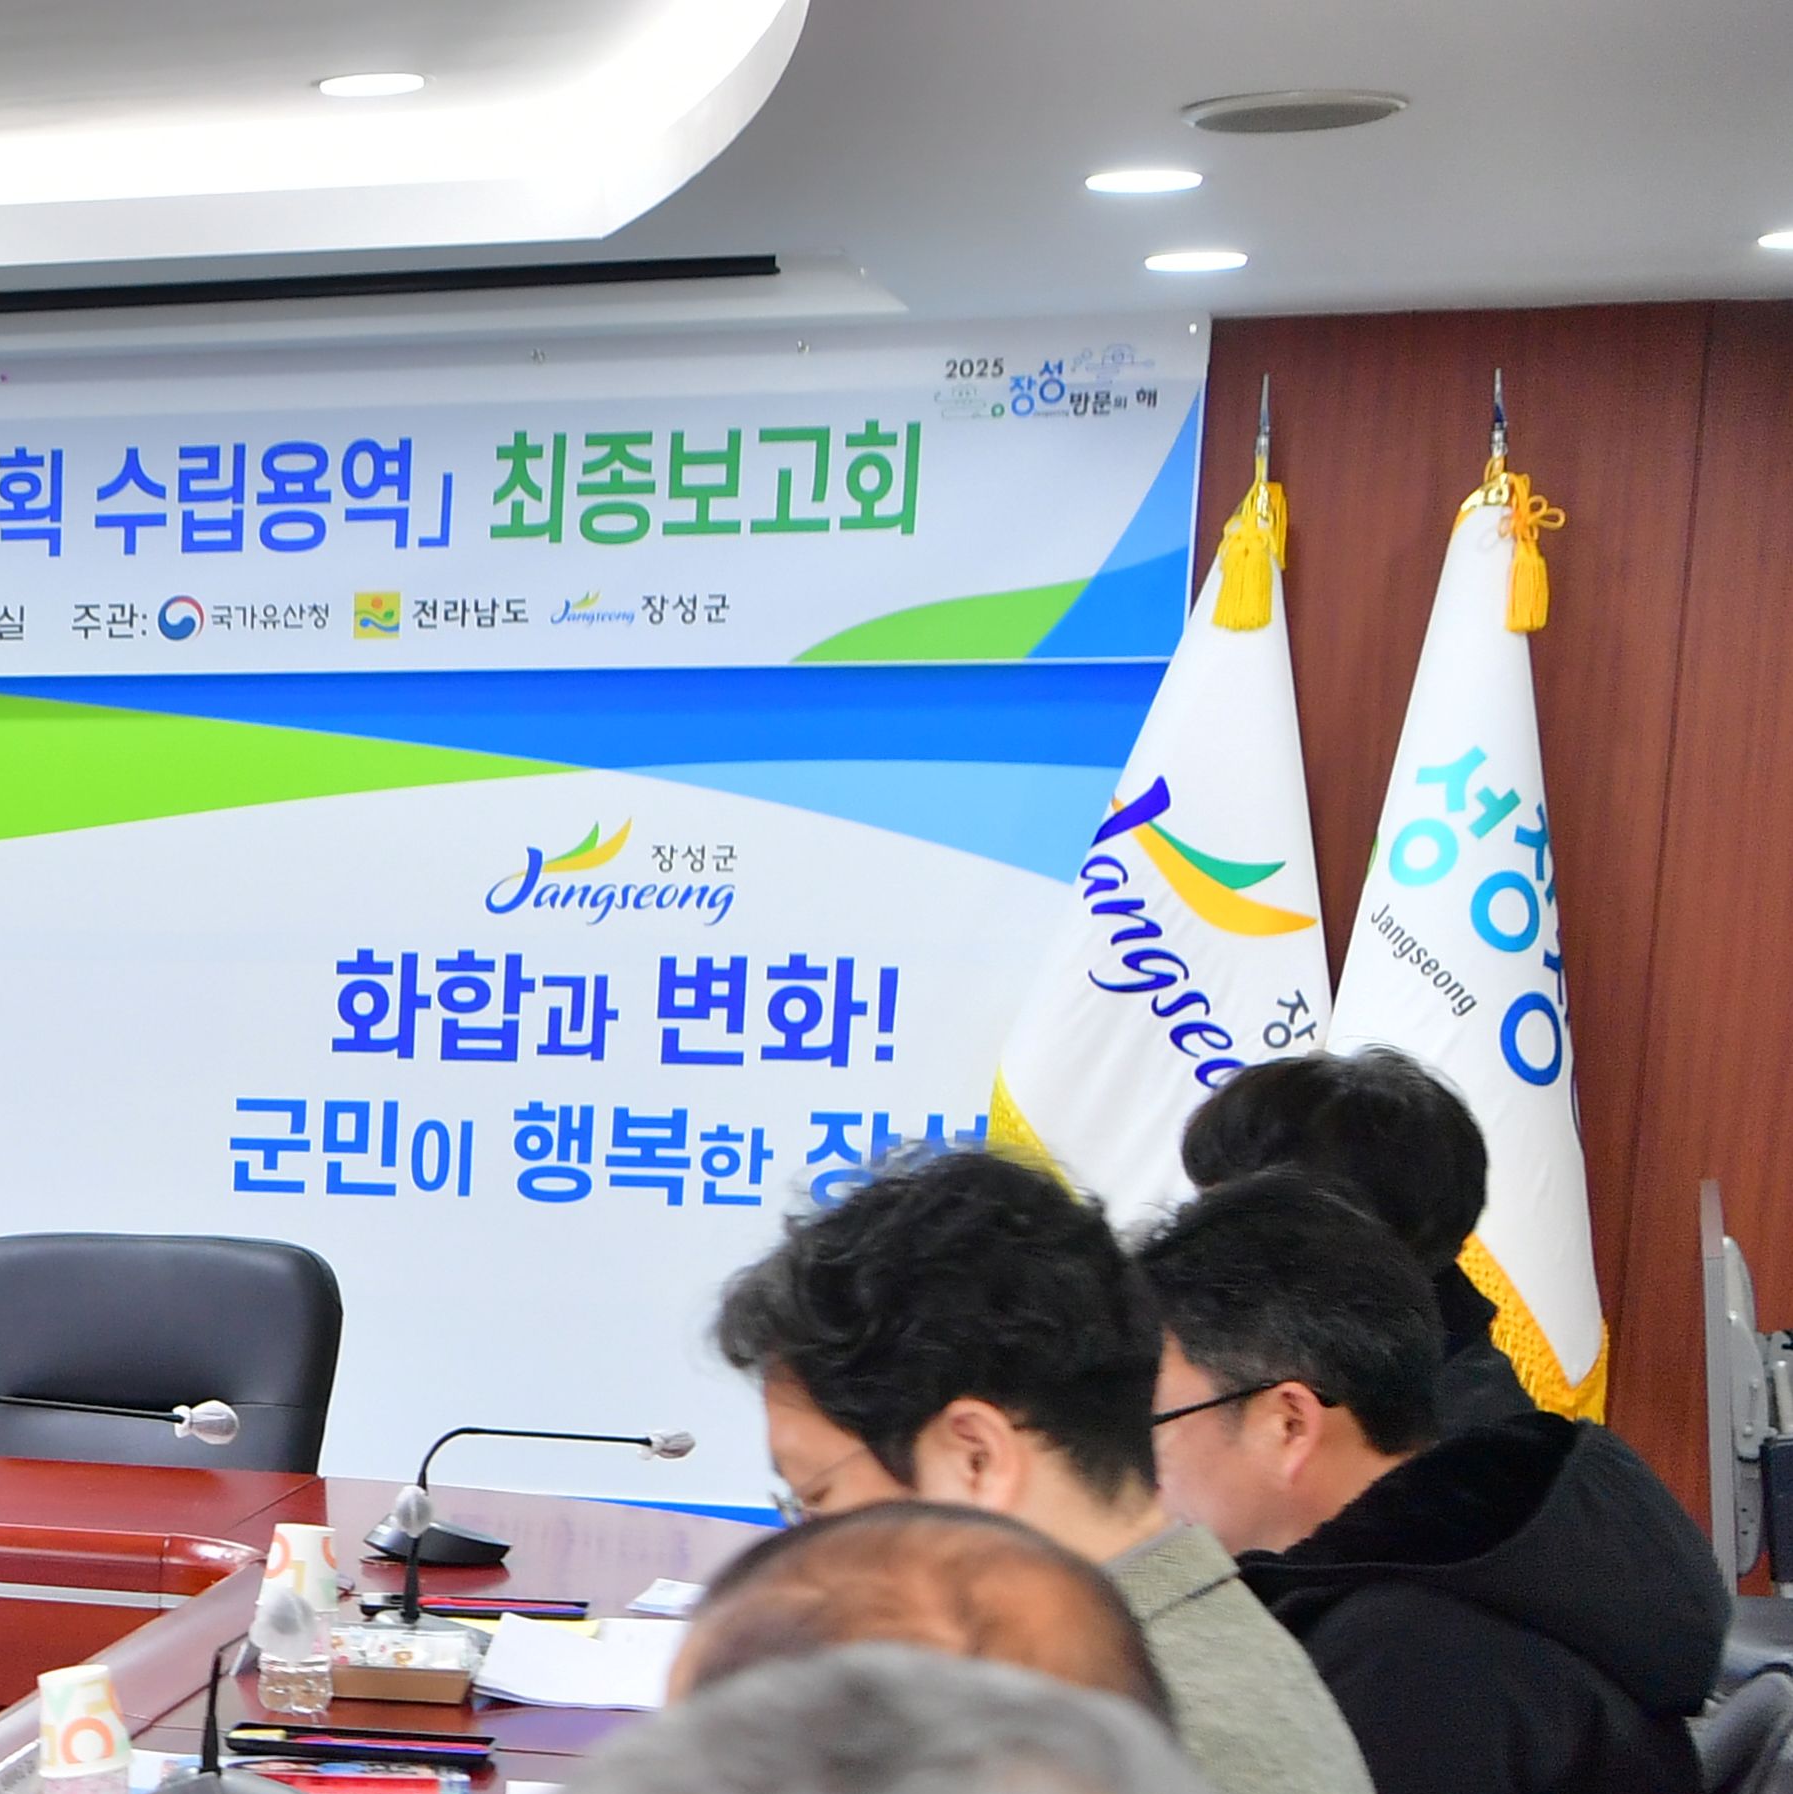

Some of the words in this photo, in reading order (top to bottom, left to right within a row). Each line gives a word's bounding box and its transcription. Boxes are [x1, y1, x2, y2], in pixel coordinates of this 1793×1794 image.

[945, 357, 1004, 379] 2025
[95, 436, 453, 556] 수립용역」
[490, 419, 921, 545] 최종보고회
[71, 602, 148, 641] 주관:
[211, 603, 330, 632] 국가유산청
[412, 597, 529, 630] 전라남도
[641, 592, 730, 625] 장성군
[651, 844, 738, 873] 장성군
[485, 846, 736, 926] Jangseong
[1370, 903, 1478, 1017] Jangseong
[331, 948, 619, 1063] 화합과
[656, 952, 899, 1068] 변화!
[229, 1097, 474, 1197] 군민이
[513, 1100, 773, 1207] 행복한
